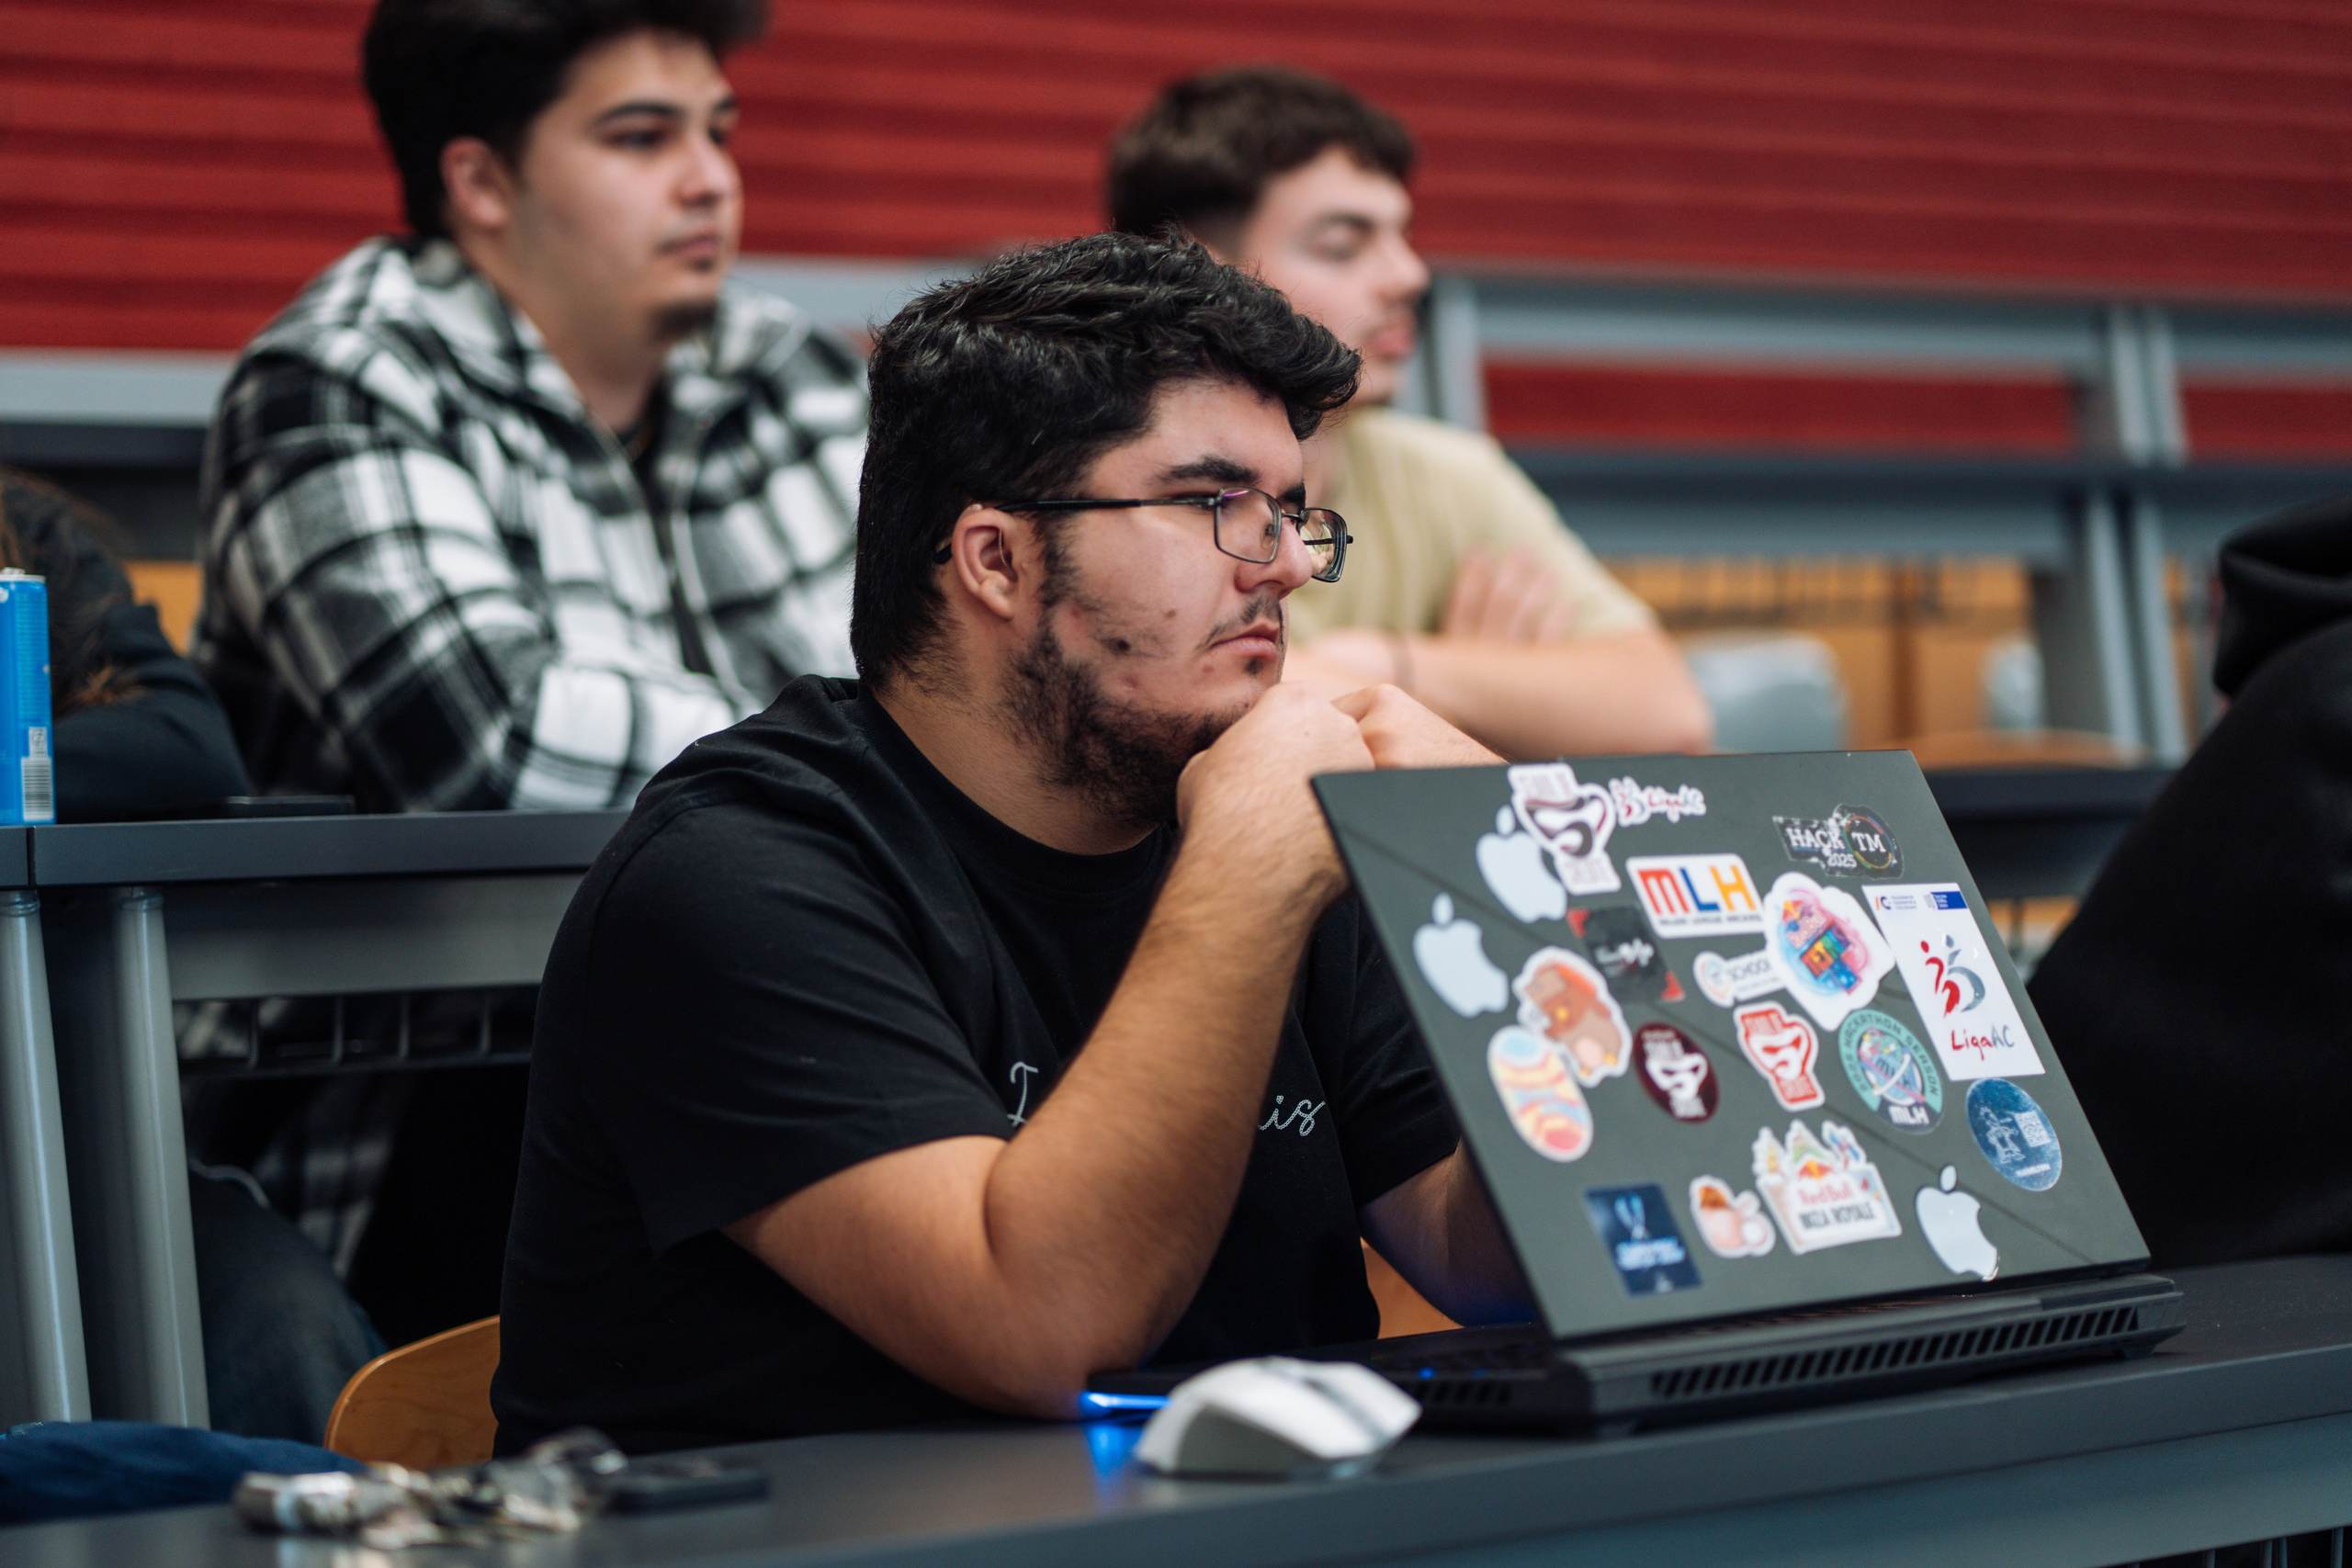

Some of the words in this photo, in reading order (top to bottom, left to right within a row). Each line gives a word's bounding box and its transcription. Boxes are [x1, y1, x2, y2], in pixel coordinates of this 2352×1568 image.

[1785, 828, 1845, 850] HACK
[1851, 831, 1886, 852] TM
[1826, 852, 1858, 868] 2025
[1637, 864, 1756, 916] MLH
[1951, 1023, 2015, 1061] LigaAC
[1888, 1105, 1930, 1125] MLH
